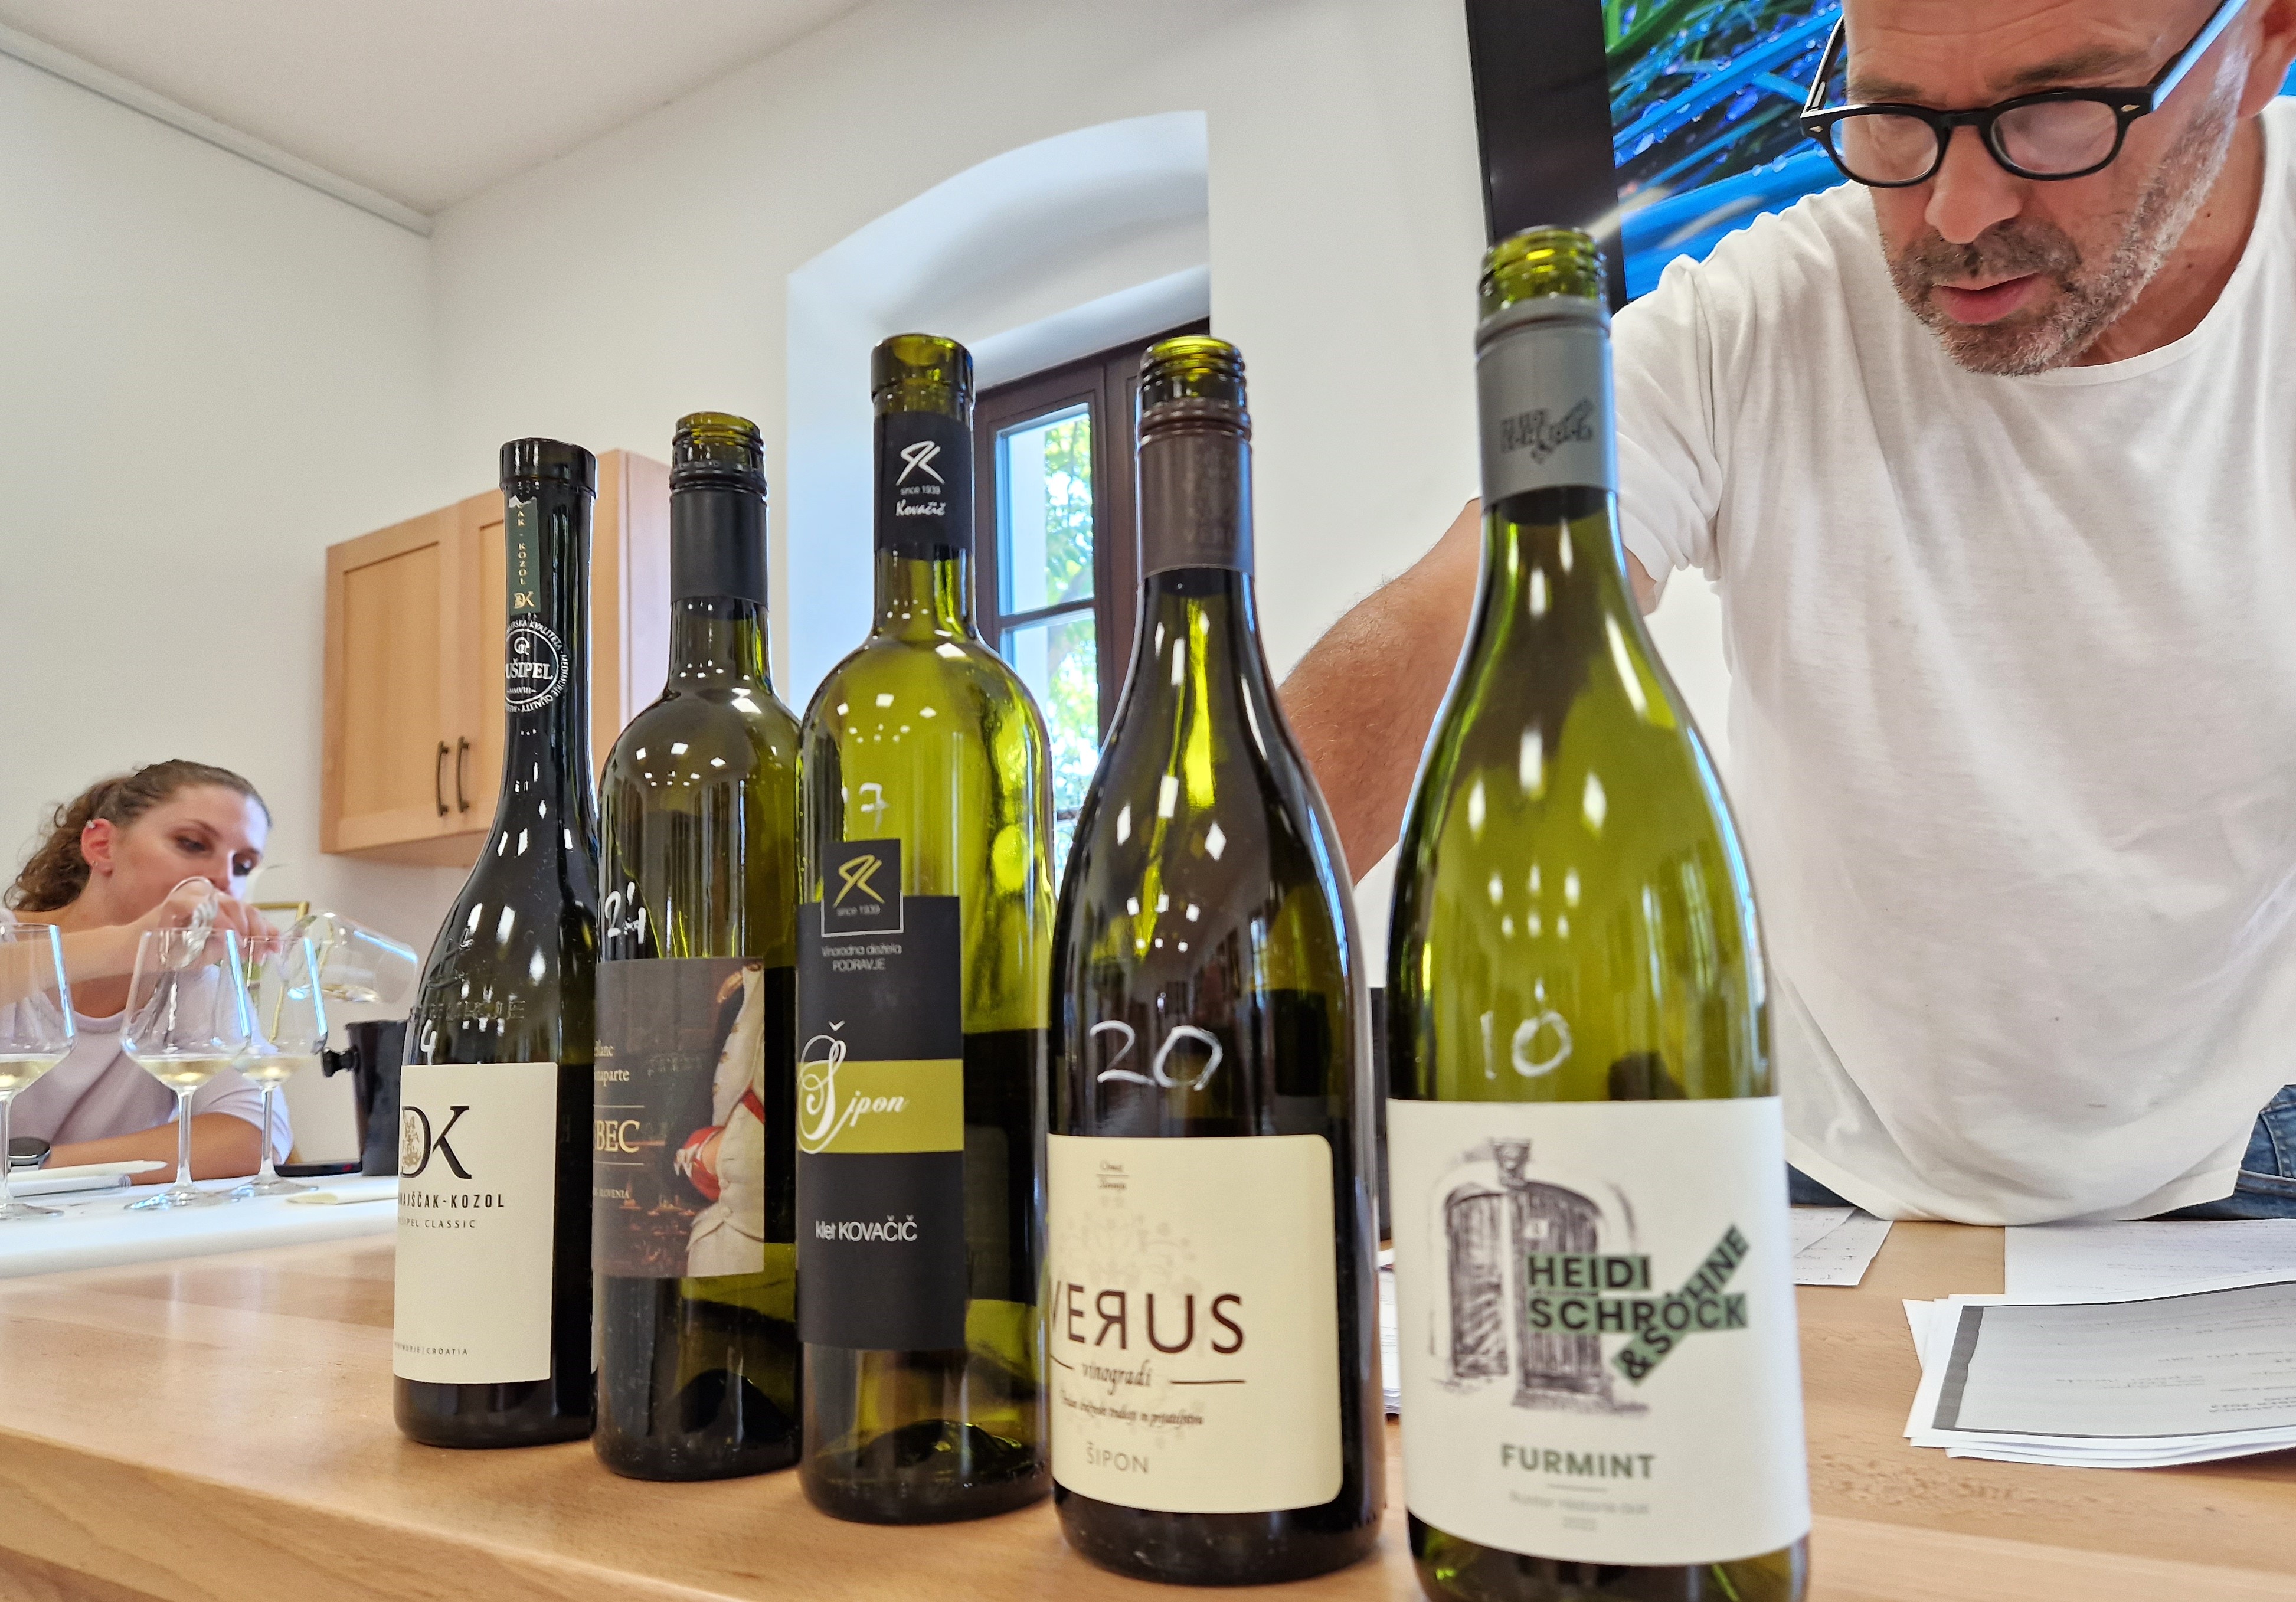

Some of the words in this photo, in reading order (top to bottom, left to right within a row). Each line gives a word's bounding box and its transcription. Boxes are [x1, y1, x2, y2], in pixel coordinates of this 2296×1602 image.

[832, 958, 886, 972] PODRAVJE
[1090, 1019, 1223, 1091] 20
[1481, 1010, 1573, 1080] 10
[797, 1020, 910, 1154] Šipon
[425, 1219, 475, 1228] CLASSIC
[838, 1214, 918, 1241] KOVAČIČ
[1528, 1255, 1650, 1289] HEIDI
[426, 1347, 467, 1356] CROATIA
[1086, 1440, 1150, 1473] ŠIPON
[1500, 1442, 1656, 1479] FURMINT
